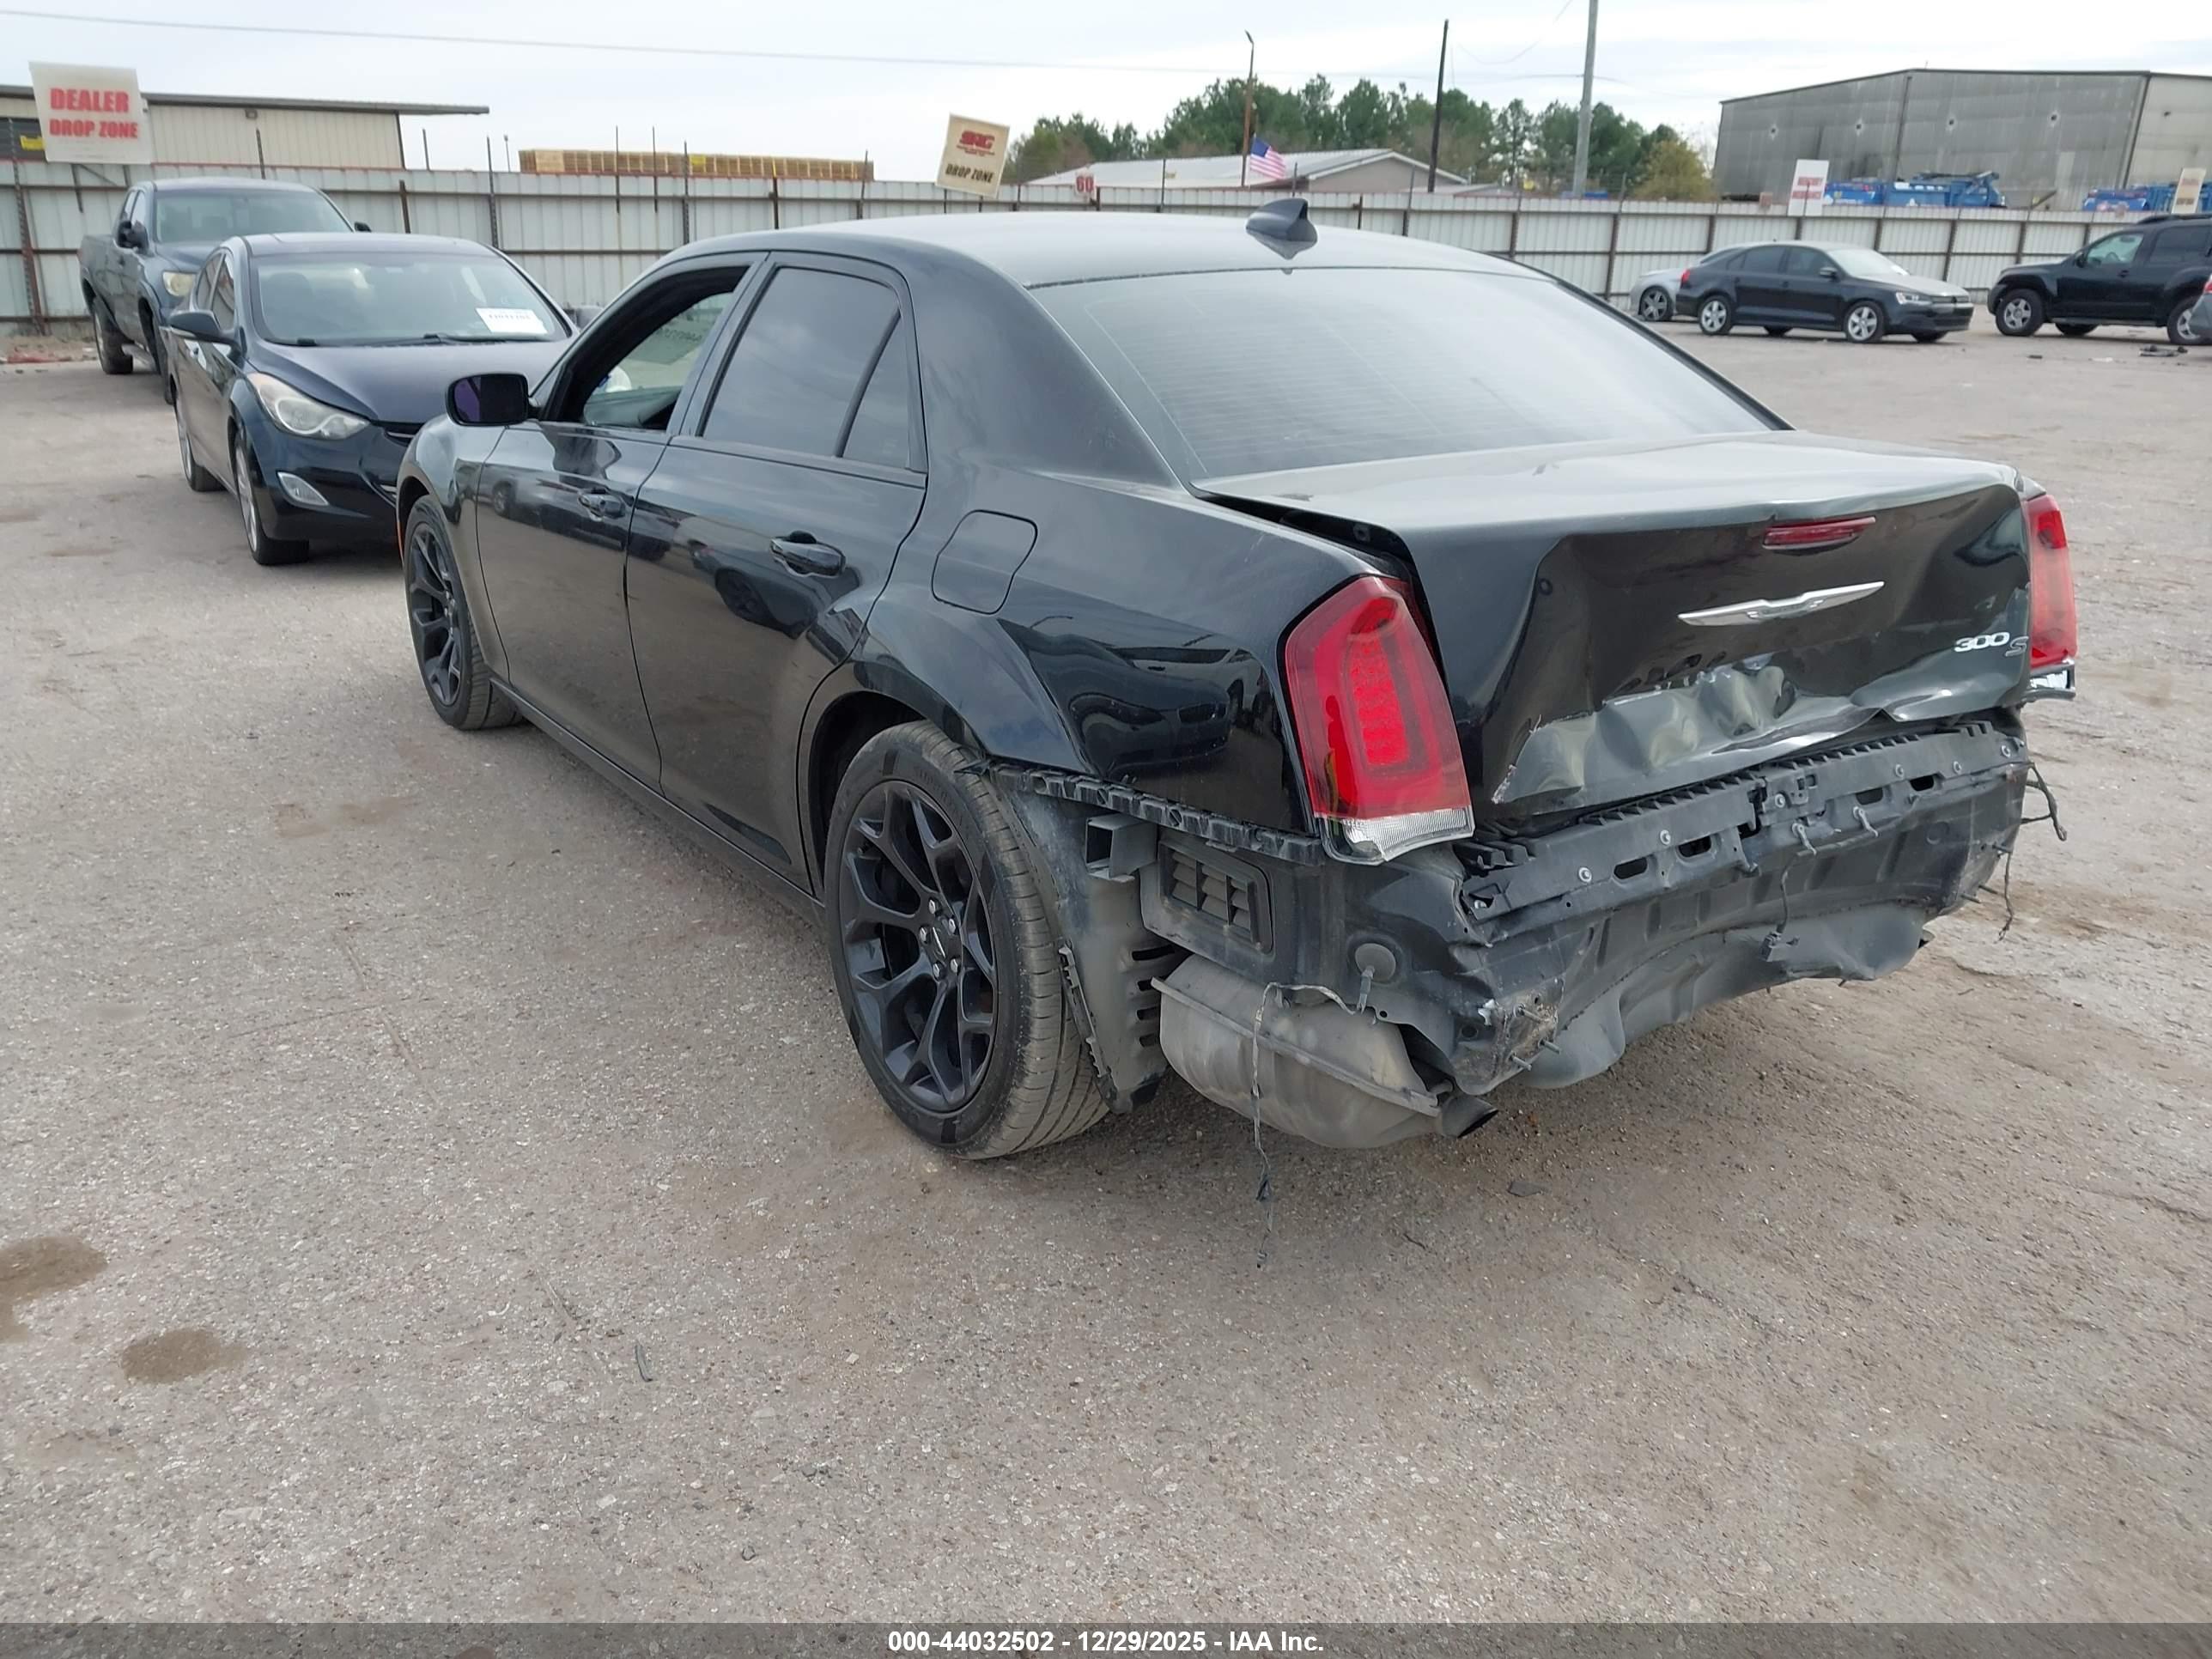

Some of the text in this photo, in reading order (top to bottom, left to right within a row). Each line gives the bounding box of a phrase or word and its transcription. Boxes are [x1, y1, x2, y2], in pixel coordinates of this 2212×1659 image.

[50, 88, 130, 112] DEALER
[49, 118, 138, 139] DROP ZONE
[945, 163, 994, 184] DROP ZONE
[1954, 632, 2009, 652] 300
